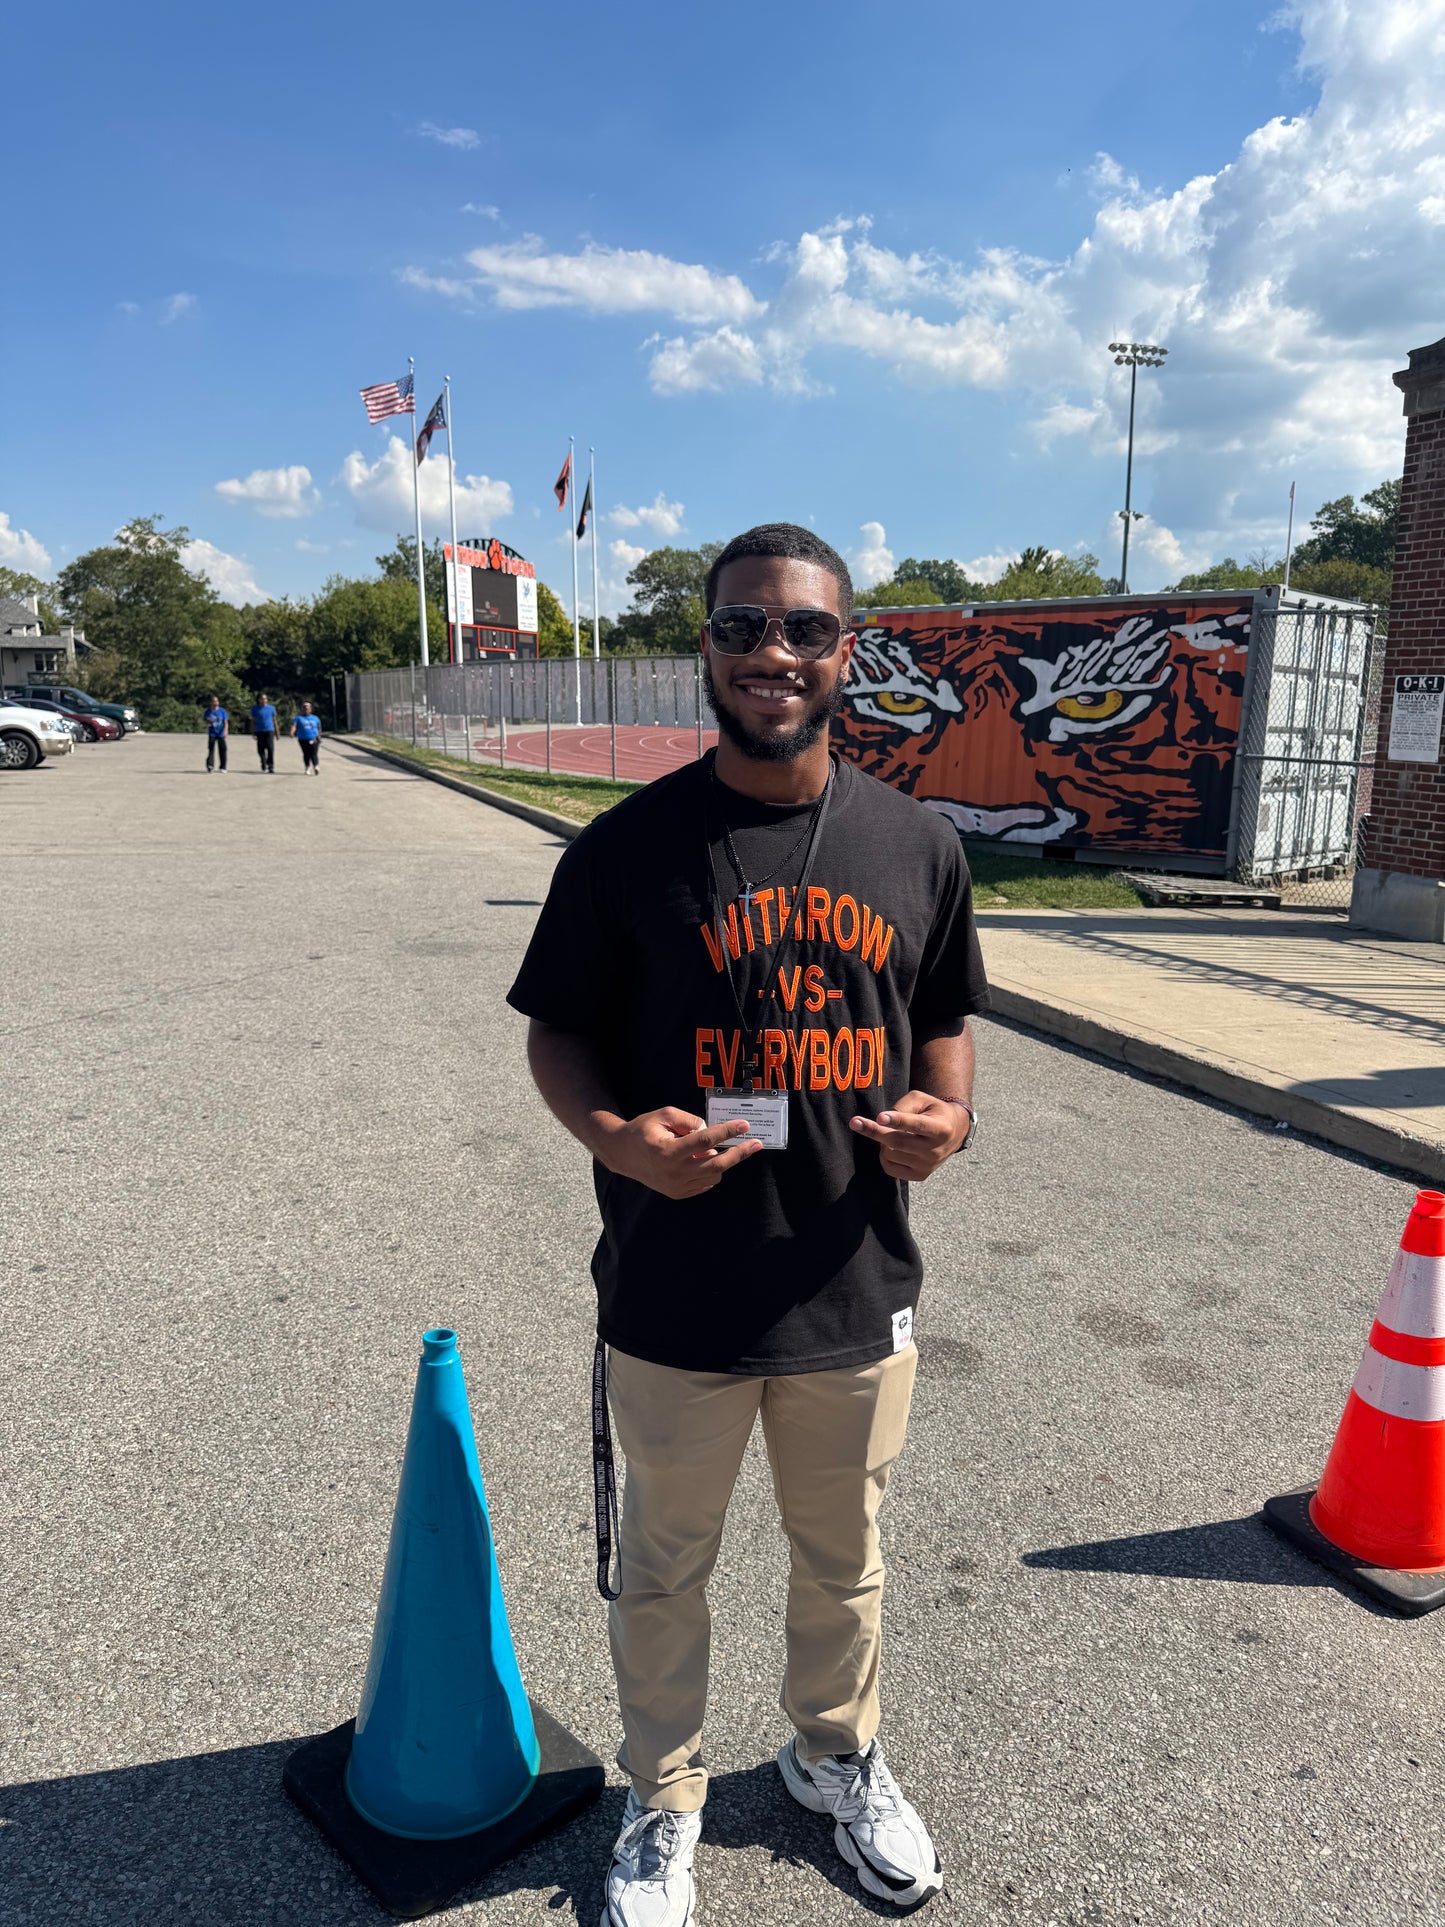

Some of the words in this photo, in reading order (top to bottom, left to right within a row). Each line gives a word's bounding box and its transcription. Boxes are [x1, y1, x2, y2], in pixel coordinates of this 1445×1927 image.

[443, 543, 488, 570] WTHROW
[1403, 677, 1439, 689] O-K-I
[700, 885, 894, 974] WITHROW
[595, 1350, 603, 1386] CINCINNATI
[594, 1386, 603, 1408] PUBLIC
[594, 1409, 604, 1436] SCHOOLS
[596, 1460, 606, 1492] CINCINNATI
[597, 1492, 607, 1513] PUBLIC
[598, 1513, 608, 1539] SCHOOLS
